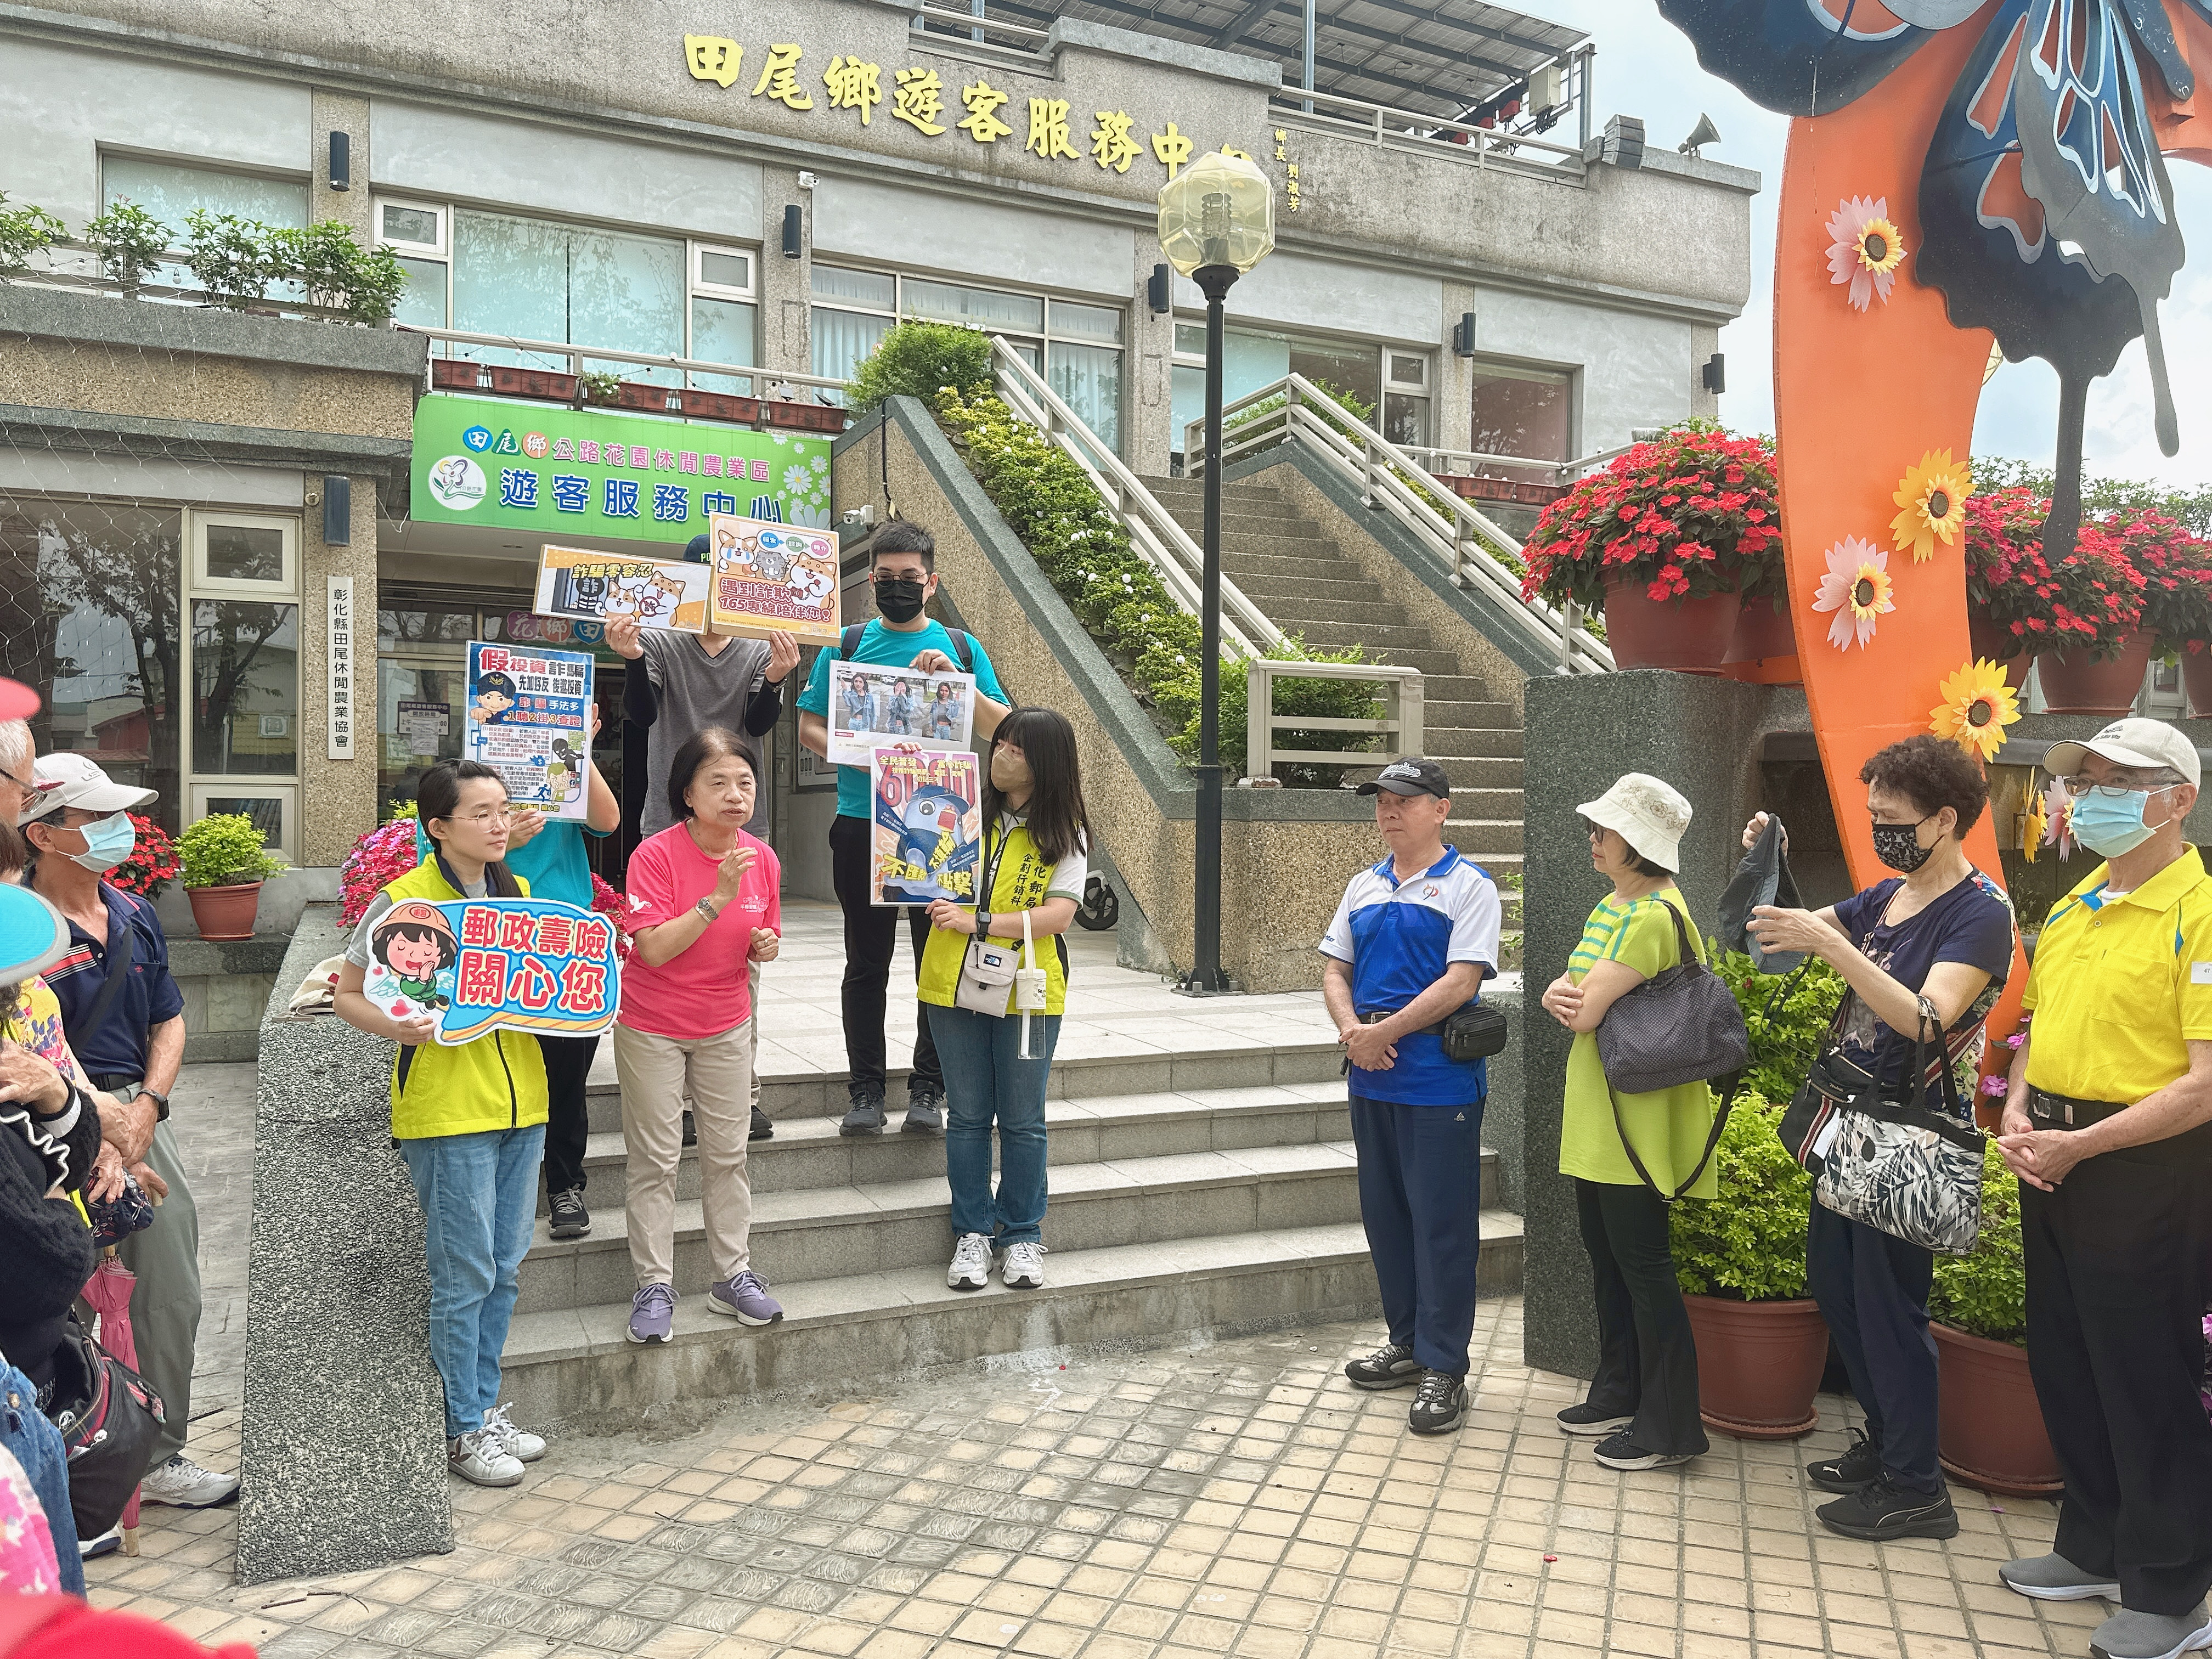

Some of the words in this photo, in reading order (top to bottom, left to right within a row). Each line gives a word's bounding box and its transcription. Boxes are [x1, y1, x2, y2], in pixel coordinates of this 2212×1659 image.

[499, 467, 782, 523] 遊客服務中心
[572, 563, 654, 579] 詐騙零容忍
[583, 578, 599, 594] 詐
[720, 578, 792, 602] 遇到詐欺
[334, 588, 348, 748] 彰化縣田尾休閒農業協會
[480, 648, 584, 678] 假投資詐騙
[519, 675, 549, 692] 先加好友
[879, 755, 917, 768] 全民普發
[937, 759, 973, 770] 當心詐騙
[881, 855, 927, 881] 不匯款
[1011, 853, 1034, 906] 企劃行銷科
[937, 871, 973, 895] 不點擊
[462, 907, 609, 961] 郵政壽險
[459, 953, 604, 1012] 關心您
